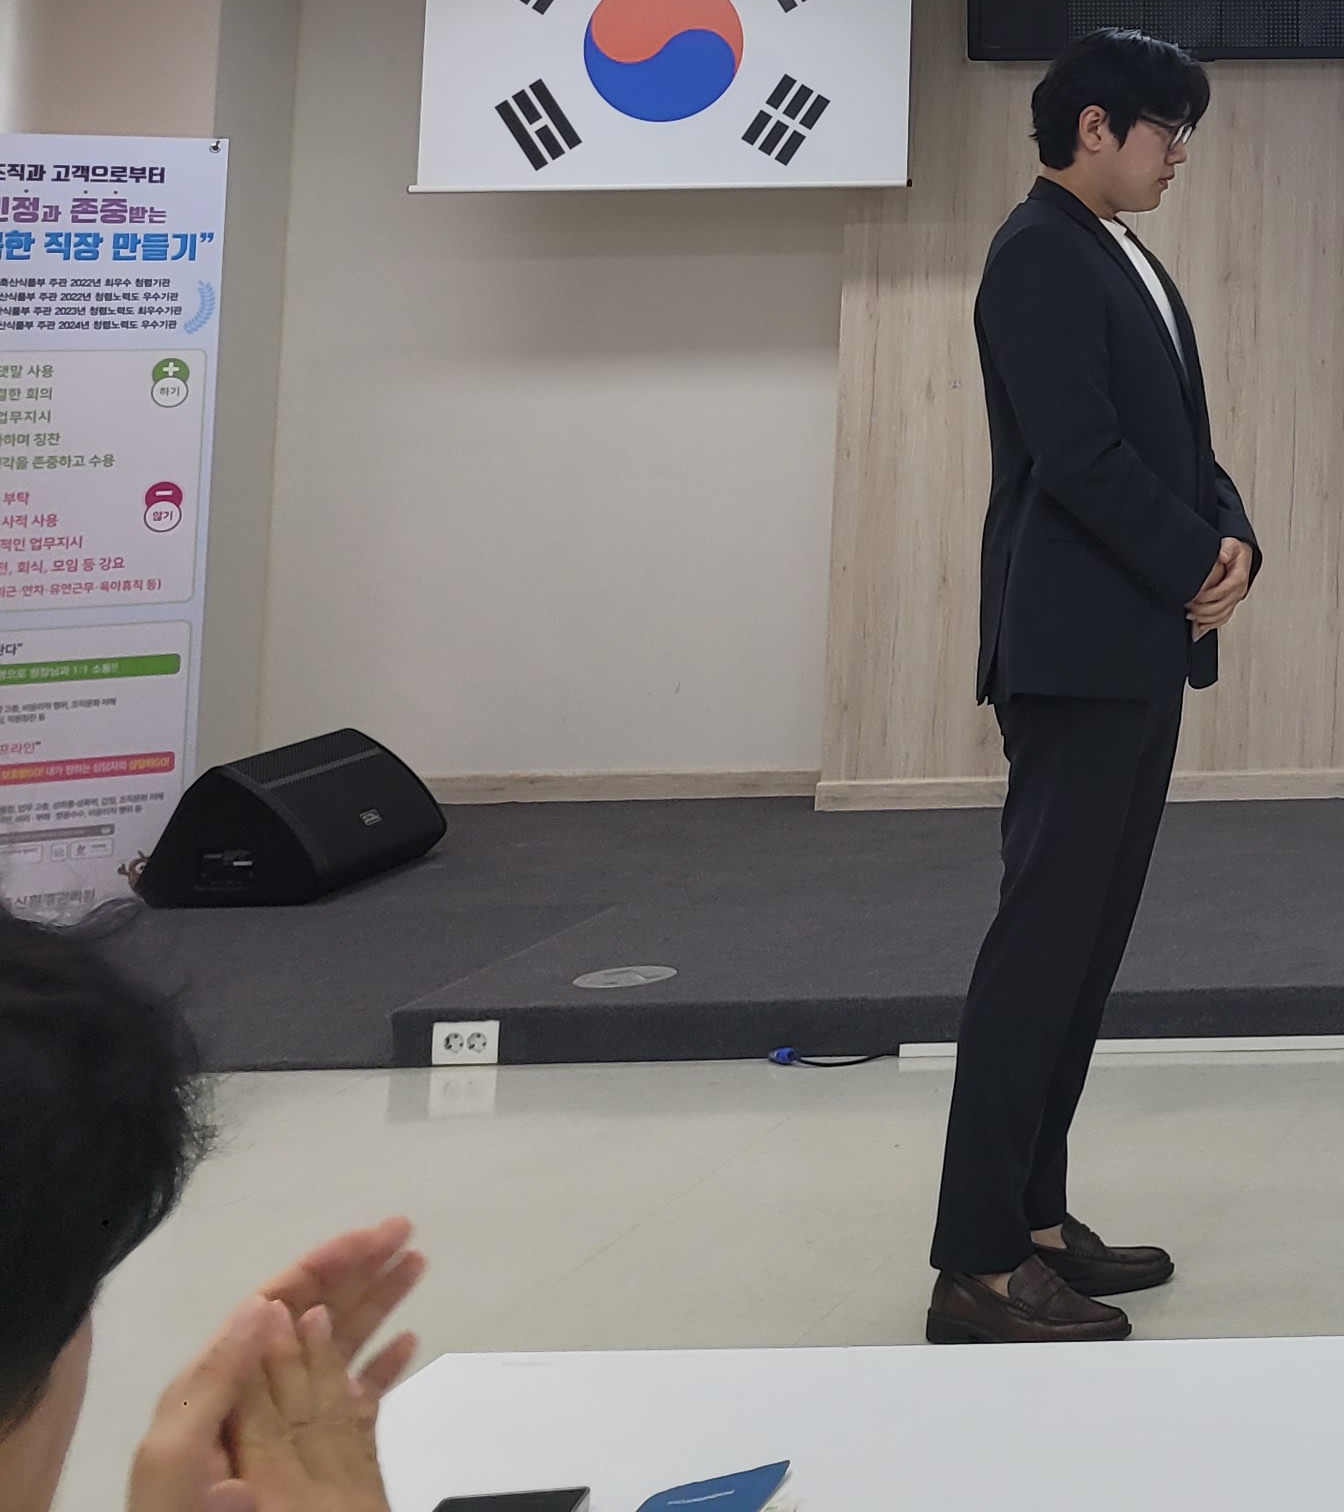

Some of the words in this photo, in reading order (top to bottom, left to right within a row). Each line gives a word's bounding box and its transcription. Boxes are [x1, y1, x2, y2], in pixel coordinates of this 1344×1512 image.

[51, 164, 166, 183] 고객으로부터
[70, 197, 167, 224] 존중받는
[0, 230, 36, 261] 한
[44, 231, 104, 262] 직장
[0, 306, 30, 316] 식품부
[27, 364, 54, 379] 사용
[26, 387, 52, 401] 회의
[159, 386, 181, 397] 하기
[0, 432, 30, 447] 하며
[34, 432, 61, 447] 칭찬
[0, 456, 28, 470] 각을
[32, 455, 86, 470] 존중하고
[88, 454, 116, 468] 수용
[3, 491, 30, 506] 부탁
[2, 514, 28, 528] 사적
[32, 513, 58, 528] 사용
[152, 510, 174, 522] 않기
[30, 535, 83, 550] 업무지시
[51, 558, 78, 572] 모임
[82, 558, 96, 572] 등
[99, 556, 125, 570] 강요
